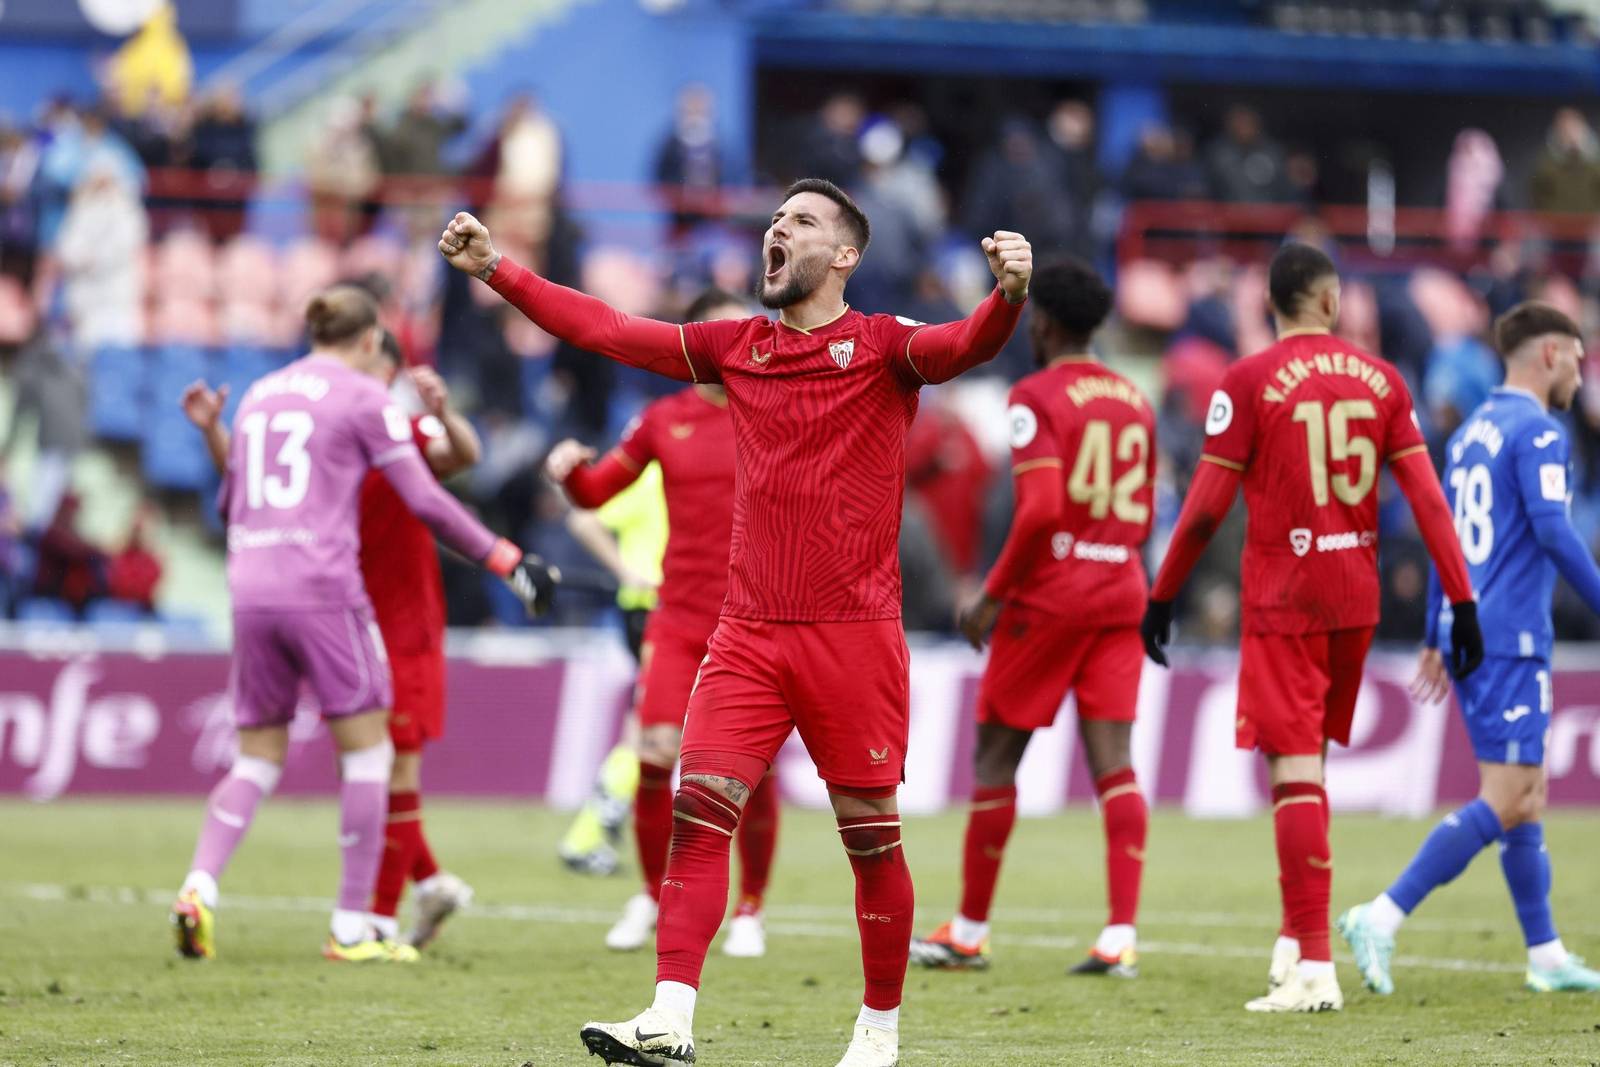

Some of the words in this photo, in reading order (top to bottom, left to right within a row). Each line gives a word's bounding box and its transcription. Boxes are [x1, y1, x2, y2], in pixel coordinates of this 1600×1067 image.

[241, 410, 315, 510] 13
[1067, 419, 1149, 525] 42
[1292, 399, 1378, 507] 15
[1450, 463, 1494, 566] 18
